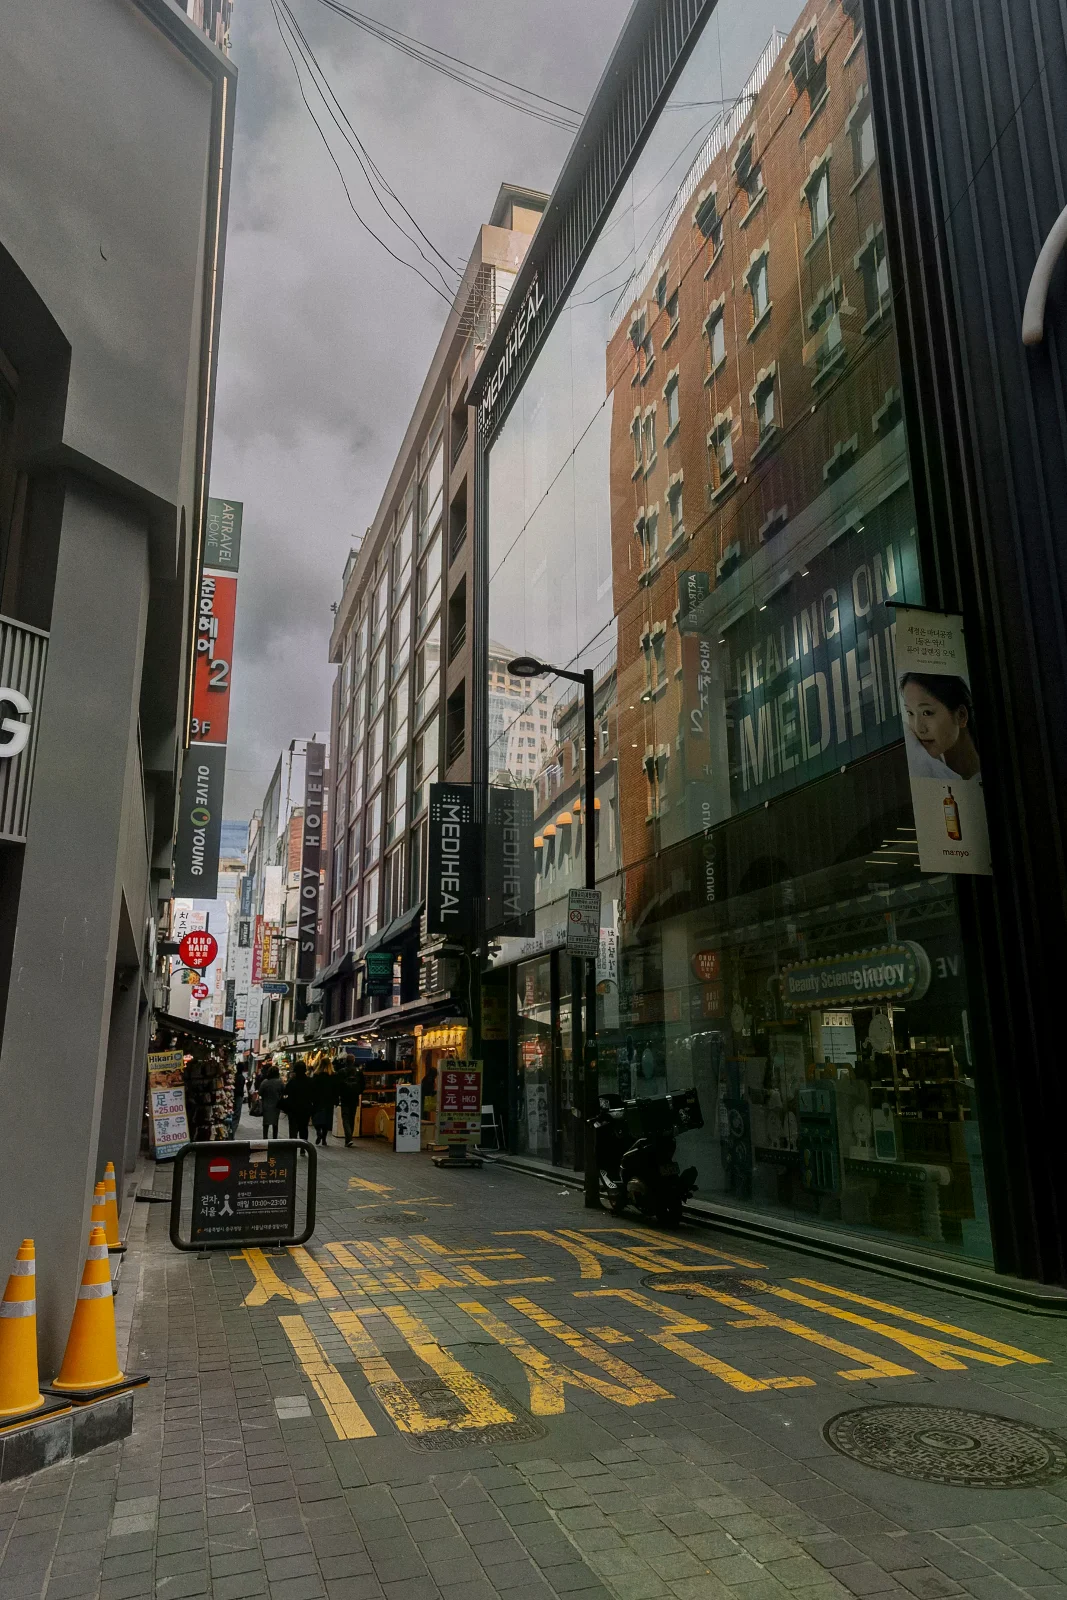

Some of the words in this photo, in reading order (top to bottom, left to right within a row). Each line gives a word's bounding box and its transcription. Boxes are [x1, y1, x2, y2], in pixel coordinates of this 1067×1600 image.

[482, 283, 545, 423] MEDIHEAL
[207, 514, 218, 548] HOME
[219, 503, 235, 563] ARTRAVEL
[736, 587, 840, 697] HEALING
[852, 543, 898, 618] ON
[0, 686, 33, 758] G
[190, 718, 211, 734] 3F
[196, 765, 210, 806] OLIVE
[305, 768, 323, 846] HOTEL
[191, 827, 206, 876] YOUNG
[441, 803, 461, 923] MEDIHEAL
[300, 867, 320, 952] SAVOY
[187, 937, 212, 945] JUNO
[188, 944, 209, 952] HAIR
[193, 958, 203, 966] 3F
[789, 974, 820, 993] Beauty
[247, 997, 259, 1029] OLENS
[149, 1054, 173, 1063] Hikari
[447, 1073, 457, 1084] $
[464, 1073, 476, 1085] ¥
[446, 1093, 457, 1104] 元
[462, 1095, 476, 1103] HKD
[200, 1206, 217, 1217] 서울
[237, 1200, 250, 1209] 매일
[252, 1199, 287, 1207] 10:00~23:00
